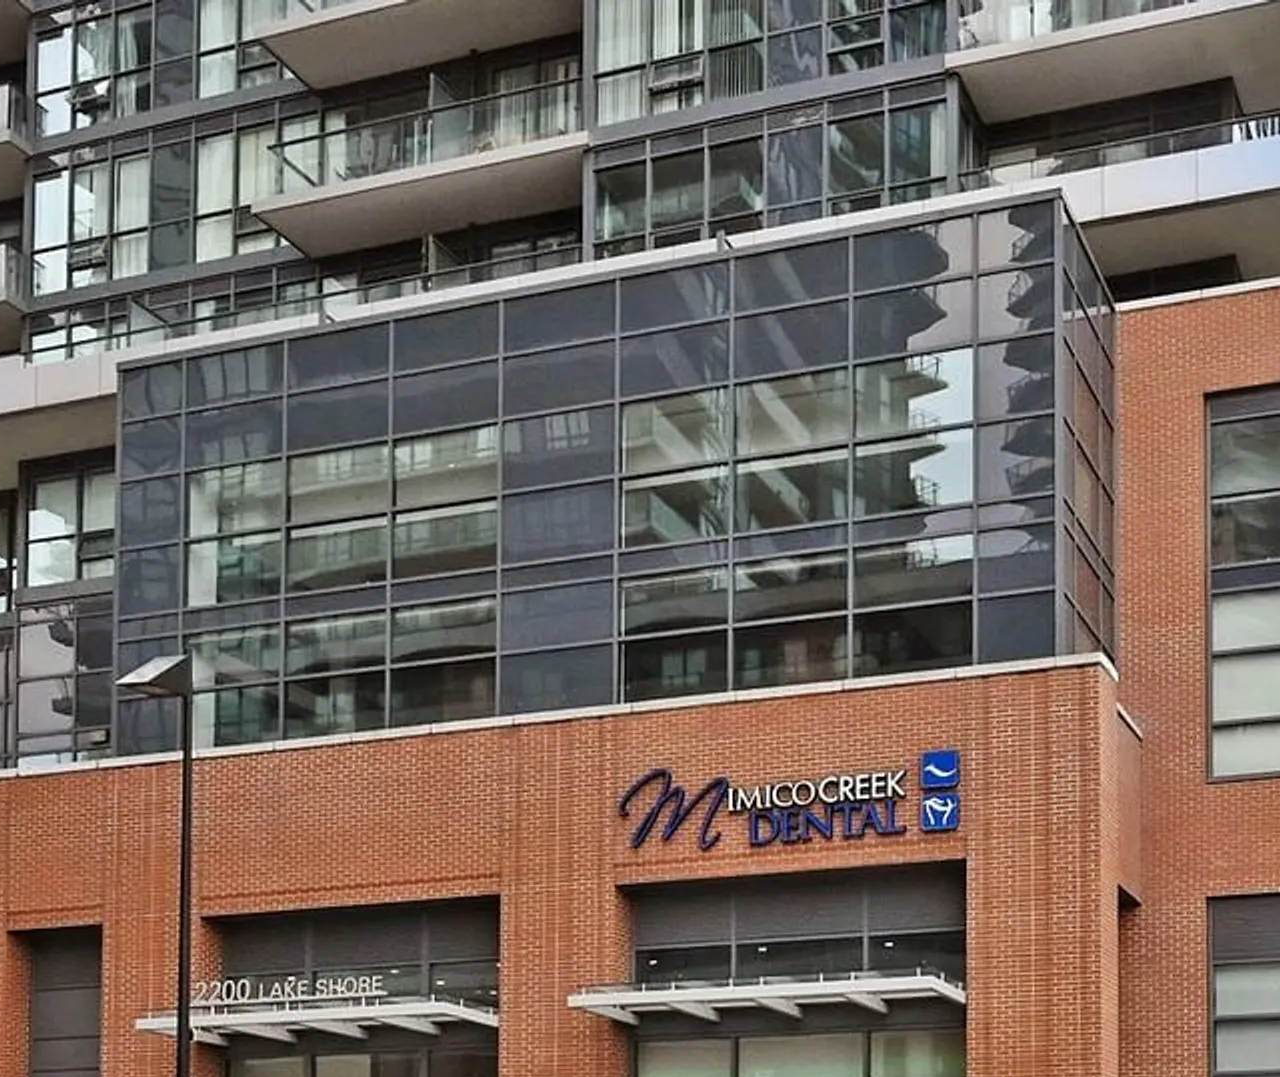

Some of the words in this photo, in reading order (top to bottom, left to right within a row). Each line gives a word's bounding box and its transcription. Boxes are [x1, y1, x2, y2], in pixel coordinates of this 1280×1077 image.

[818, 769, 907, 804] CREEK
[748, 799, 907, 847] DENTAL
[195, 978, 251, 1003] 2200
[259, 979, 308, 999] LAKE
[315, 975, 384, 998] SHORE
